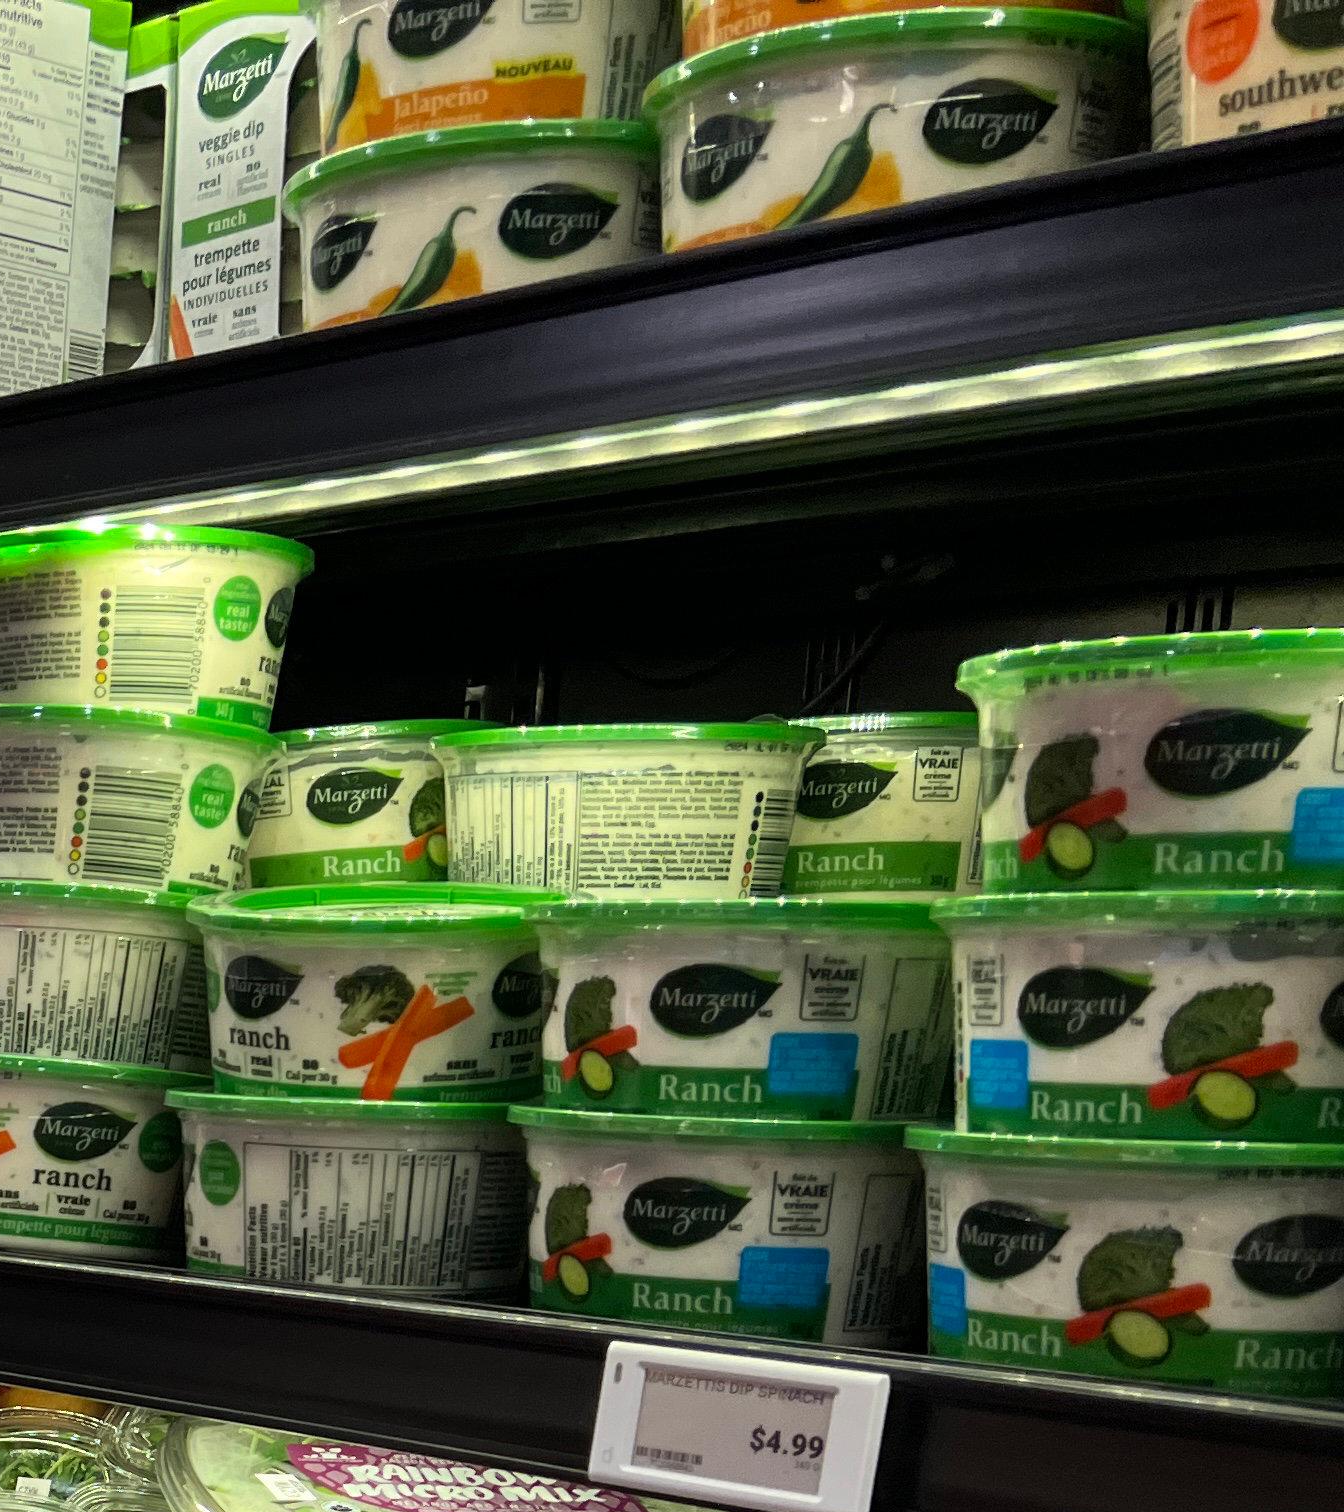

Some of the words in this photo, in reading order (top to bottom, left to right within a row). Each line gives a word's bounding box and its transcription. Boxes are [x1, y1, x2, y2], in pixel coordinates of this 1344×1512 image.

[0, 8, 43, 28] nutritive
[394, 2, 481, 42] Marzetti
[203, 56, 273, 103] Marzetti
[495, 57, 574, 79] NOUVEAU
[393, 86, 489, 121] Jalapeño
[198, 128, 240, 154] veggie
[242, 120, 265, 147] dip
[934, 104, 1037, 151] Marzetti
[205, 144, 256, 170] SINGLES
[245, 159, 261, 174] no
[685, 135, 755, 183] Marzetti
[198, 173, 221, 191] real
[206, 210, 248, 236] ranch
[508, 206, 600, 246] Marzetti
[193, 237, 261, 268] trempette
[182, 269, 213, 296] pour
[215, 255, 272, 289] légumes
[182, 280, 269, 312] INDIVIDUELLES
[226, 604, 250, 619] real
[918, 757, 960, 770] VRAIE
[1159, 737, 1281, 779] Marzetti
[202, 793, 224, 806] real
[314, 784, 389, 815] Marzetti
[799, 777, 879, 810] Marzetti
[322, 851, 402, 879] Ranch
[796, 849, 884, 875] Ranch
[1154, 840, 1286, 875] Ranch
[808, 969, 859, 983] VRAIE
[228, 977, 287, 1010] Marzetti
[659, 988, 757, 1023] Marzetti
[1024, 993, 1128, 1033] Marzetti
[229, 1026, 290, 1051] ranch
[250, 1054, 273, 1067] real
[658, 1074, 762, 1104] Ranch
[1031, 1091, 1143, 1124] Ranch
[42, 1119, 119, 1152] Marzetti
[32, 1168, 112, 1192] ranch
[777, 1183, 829, 1198] VRAIE
[56, 1193, 91, 1207] vraie
[53, 1221, 87, 1238] pour
[632, 1198, 728, 1236] Marzetti
[960, 1224, 1046, 1266] Marzetti
[632, 1283, 733, 1314] Ranch
[967, 1318, 1063, 1358] Ranch
[728, 1379, 754, 1397] DIP
[756, 1384, 826, 1406] SPINACH
[750, 1425, 824, 1460] $4.99
[352, 1464, 558, 1488] RAINBOW
[343, 1482, 498, 1502] MICRO
[500, 1485, 610, 1503] MIX
